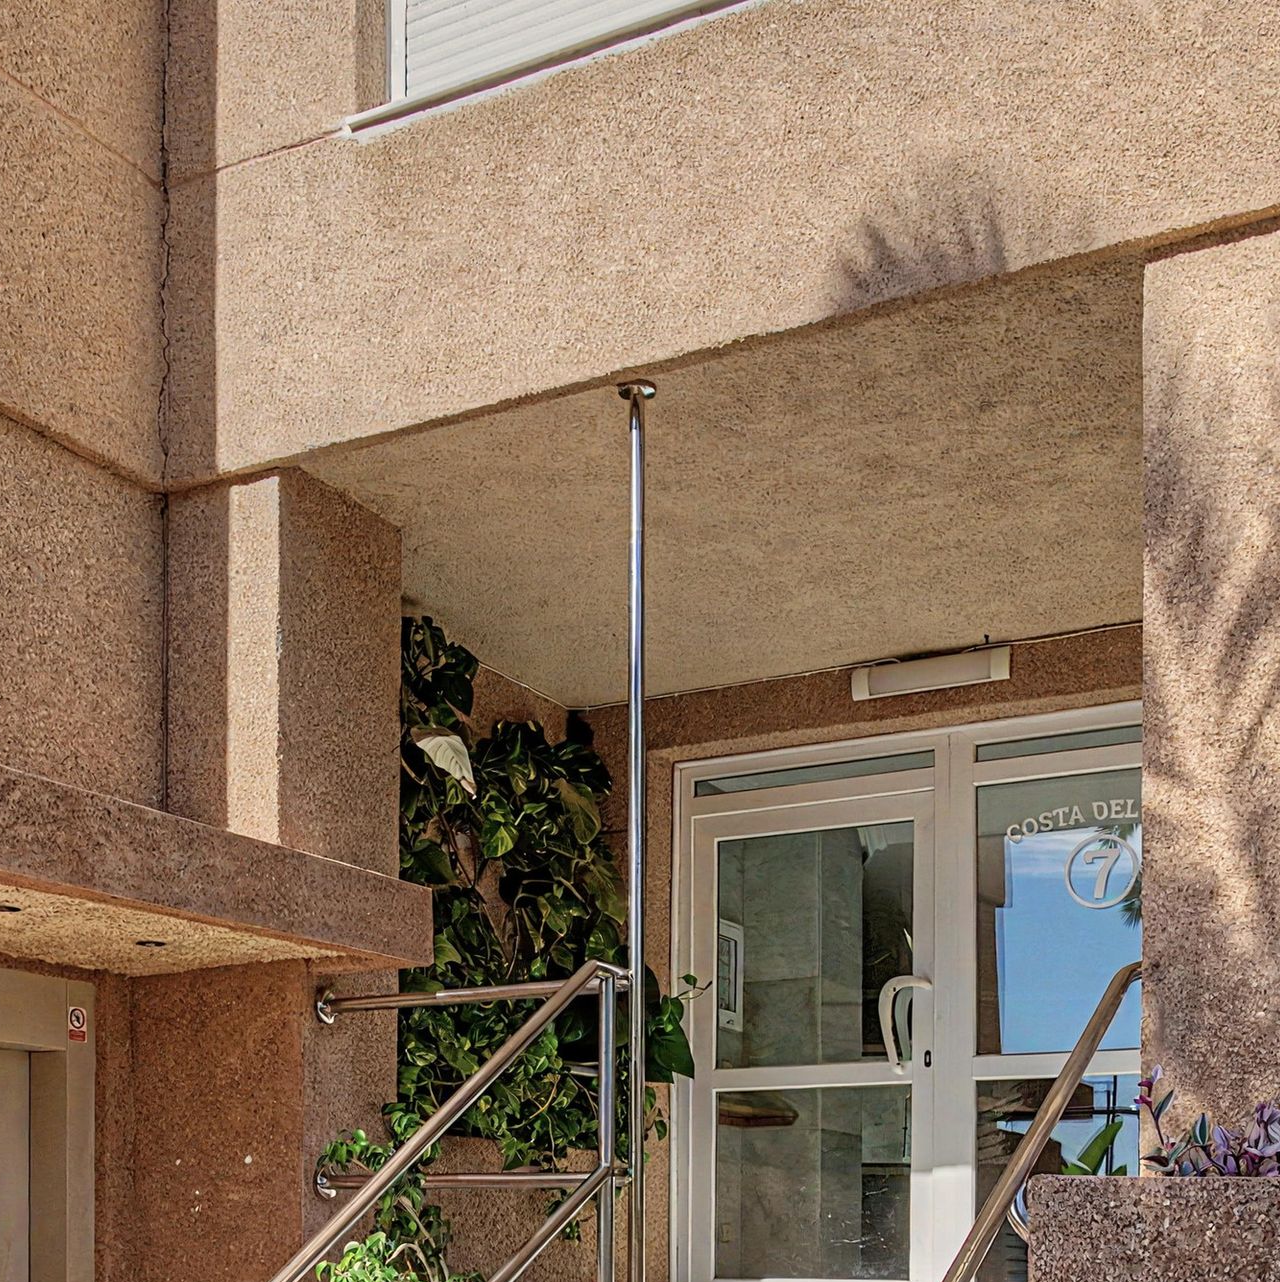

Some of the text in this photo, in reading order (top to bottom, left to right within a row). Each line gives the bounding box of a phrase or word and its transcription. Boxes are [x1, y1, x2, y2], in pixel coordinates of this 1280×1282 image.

[1007, 799, 1139, 843] COSTA DEL
[1084, 849, 1121, 899] 7
